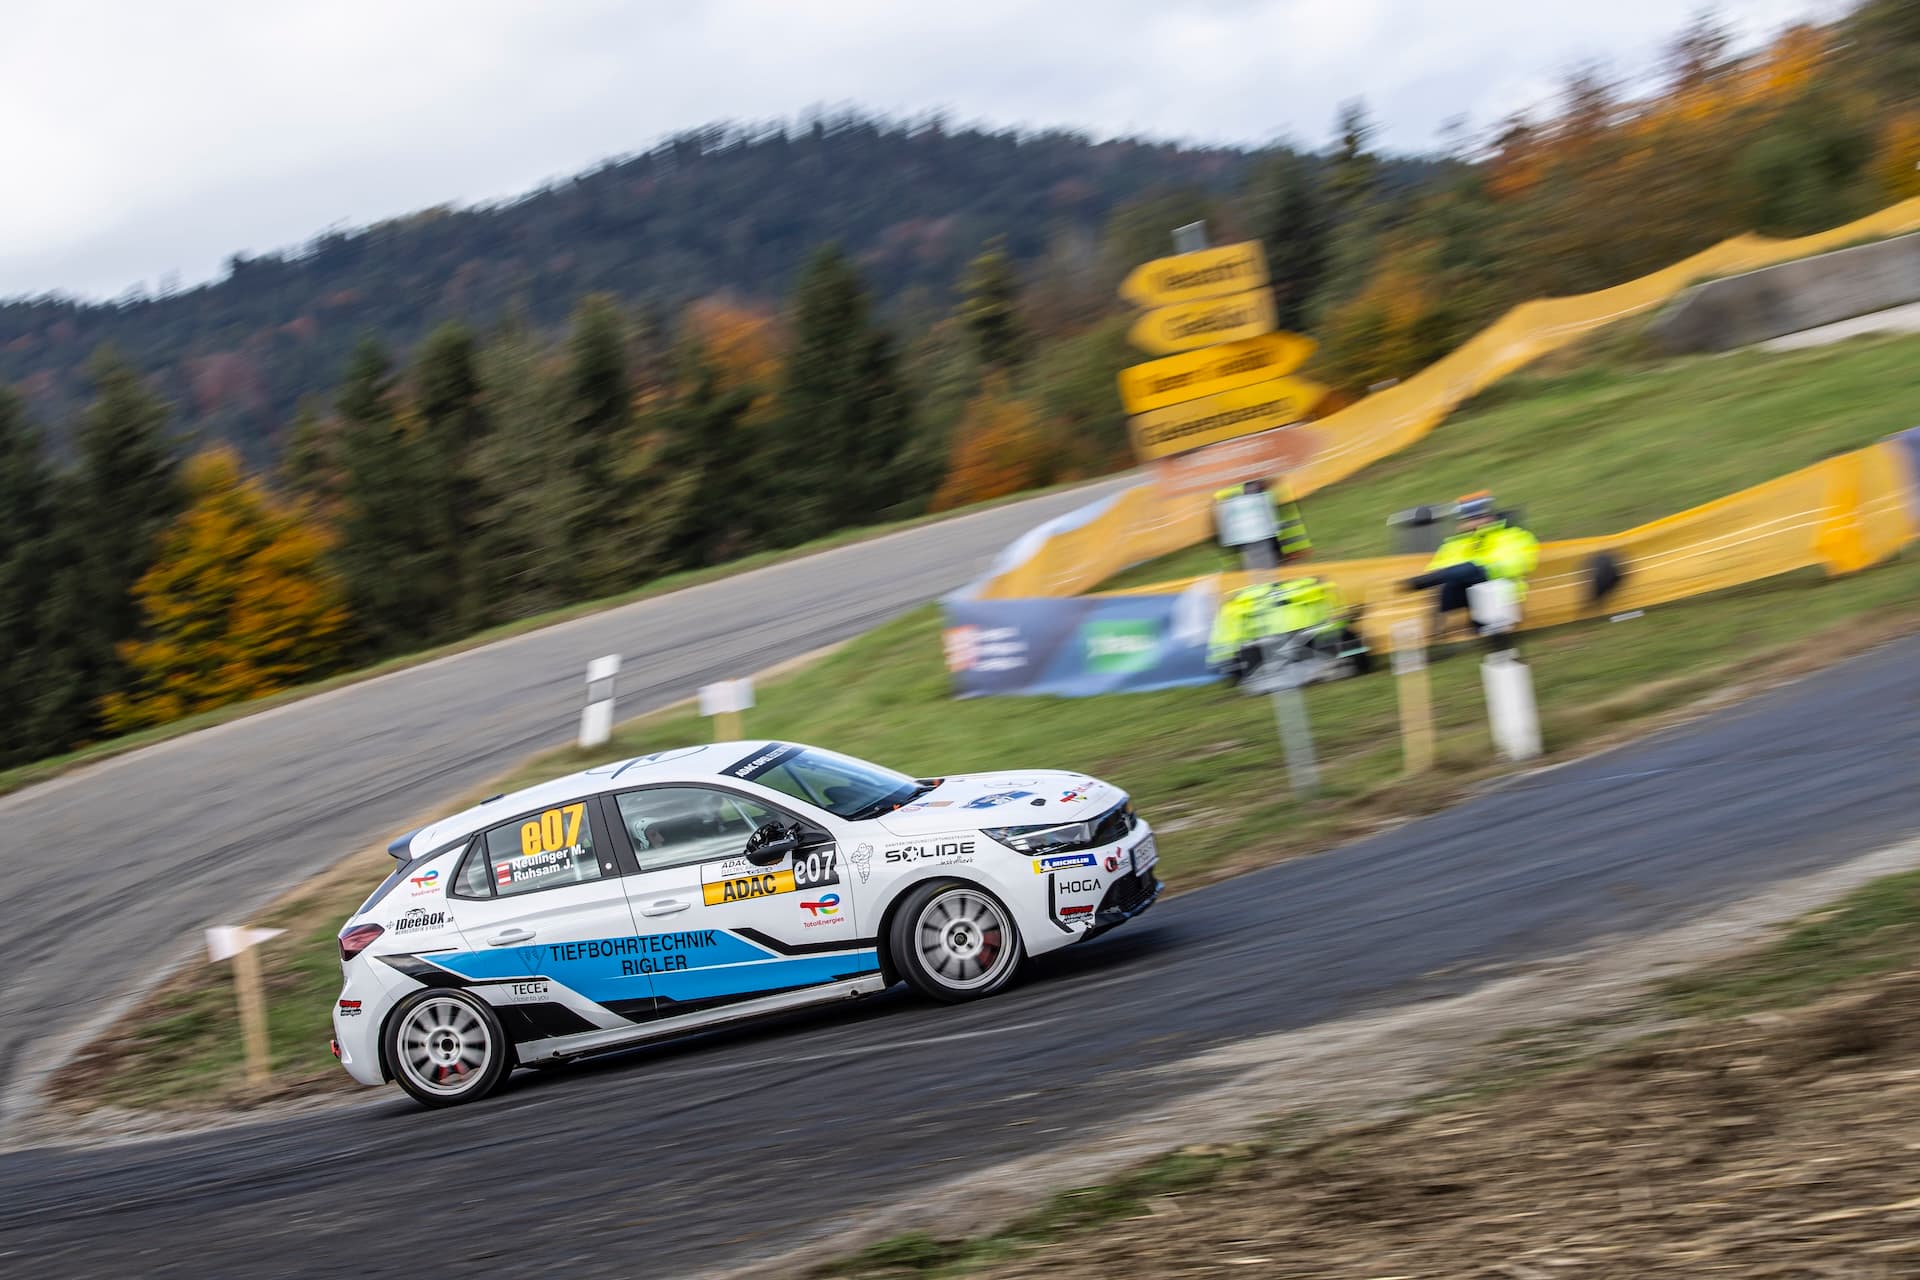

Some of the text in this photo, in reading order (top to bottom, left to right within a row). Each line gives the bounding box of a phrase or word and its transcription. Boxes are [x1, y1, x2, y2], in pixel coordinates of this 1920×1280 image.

[521, 802, 584, 856] e07
[512, 844, 585, 870] Neulinger M.
[722, 859, 747, 869] ADAC
[794, 850, 834, 885] e07
[1052, 857, 1090, 868] MICHELIN
[513, 859, 574, 882] Ruhsam J.
[724, 874, 777, 901] ADAC
[1059, 879, 1102, 894] HOGA
[804, 916, 844, 929] TotalEnergies
[550, 930, 717, 961] TIEFBOHRTECHNIK
[622, 955, 688, 976] RIGLER
